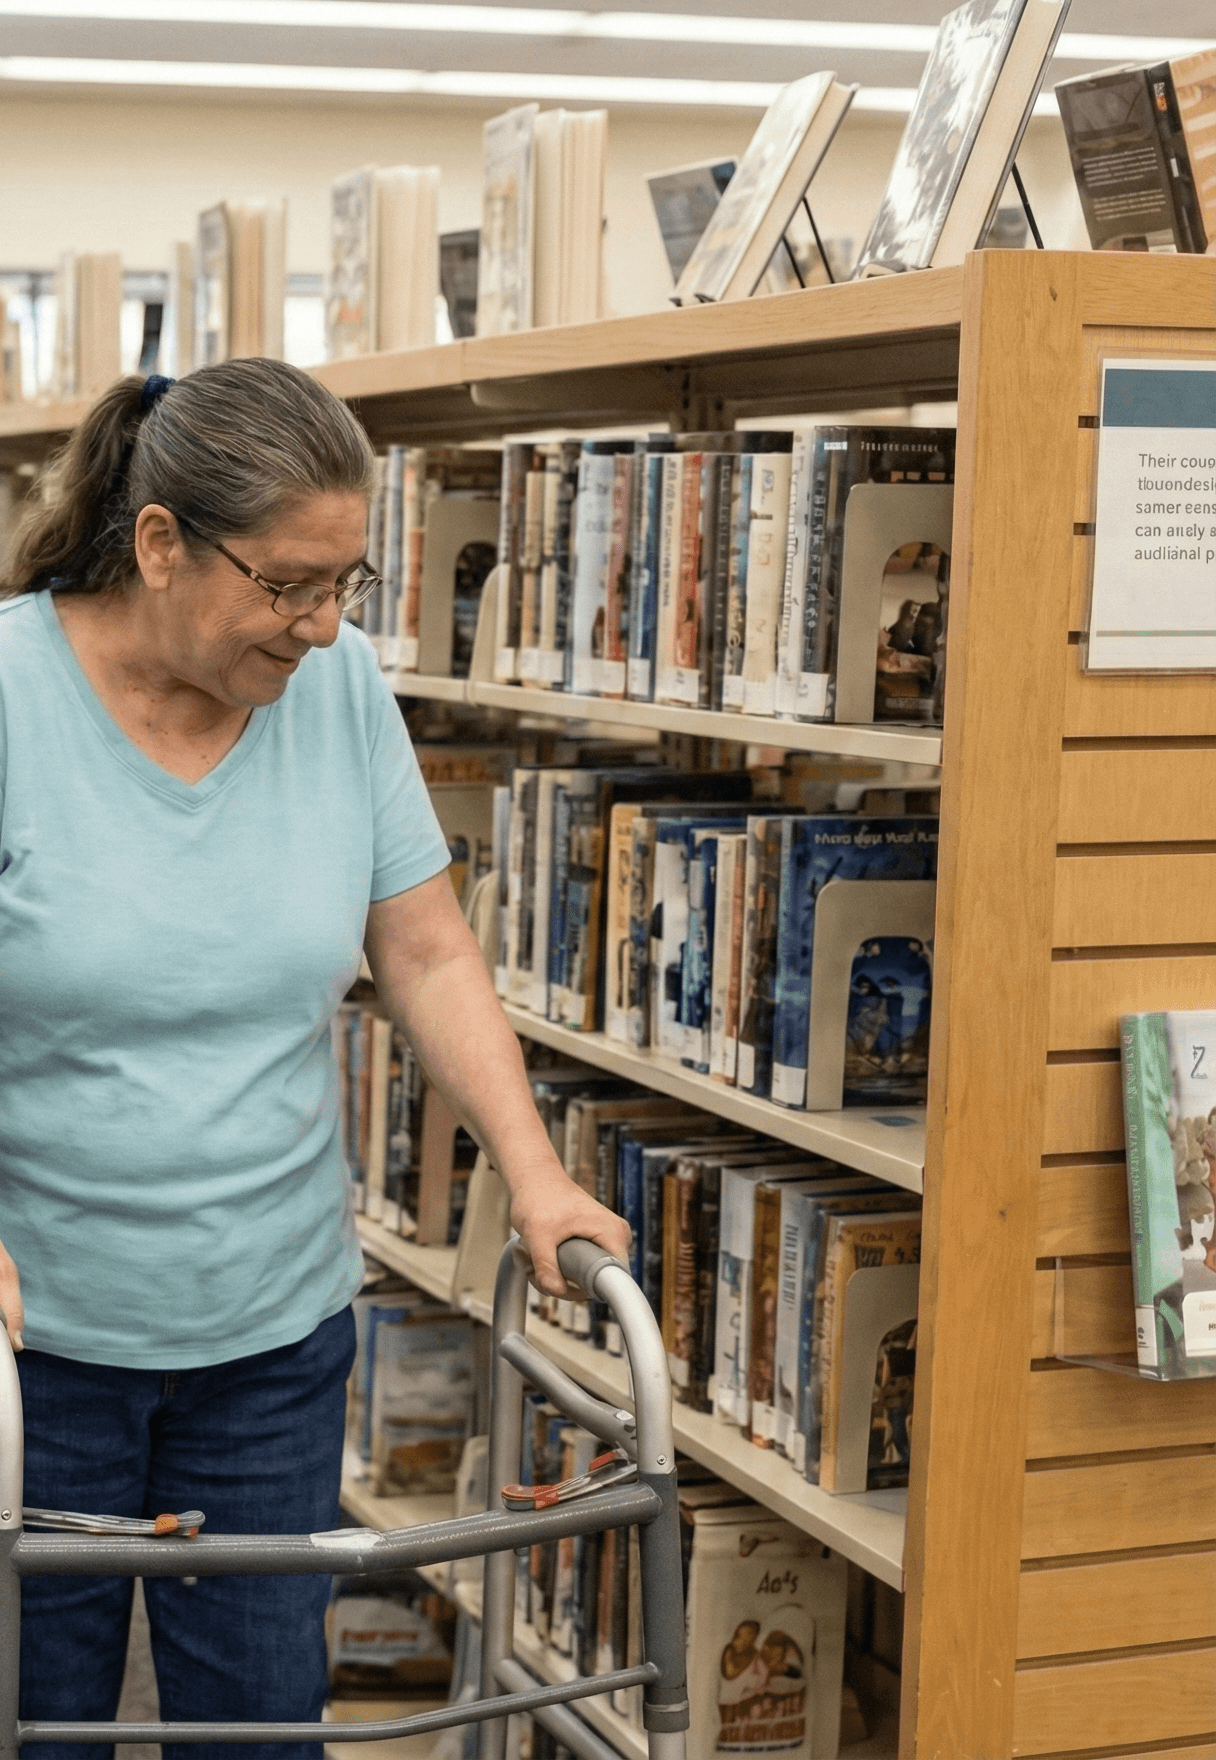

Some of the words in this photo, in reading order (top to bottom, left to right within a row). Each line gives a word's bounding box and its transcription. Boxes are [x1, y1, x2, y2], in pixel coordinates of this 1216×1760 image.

[1138, 453, 1177, 468] Their
[1135, 502, 1182, 514] samer
[1135, 525, 1161, 537] can
